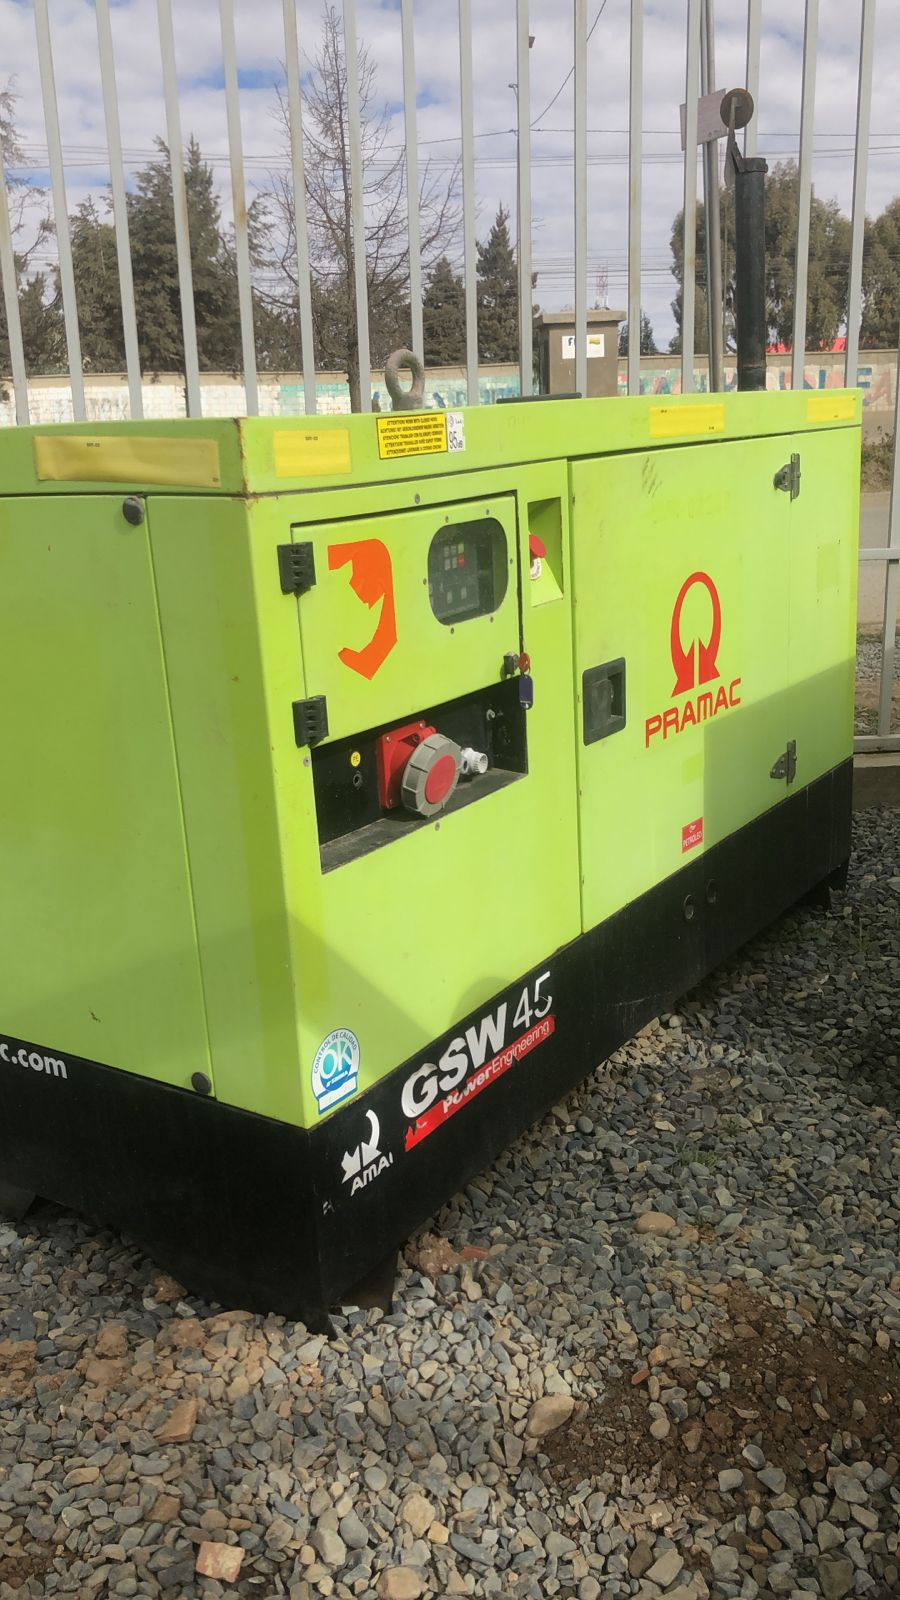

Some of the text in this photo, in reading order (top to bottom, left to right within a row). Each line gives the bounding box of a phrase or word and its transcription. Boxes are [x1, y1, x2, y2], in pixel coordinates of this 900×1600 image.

[645, 678, 741, 749] PRAMAC
[313, 1031, 358, 1074] CONTROL DE CALIDAD
[319, 1039, 352, 1080] OK
[401, 970, 553, 1118] GSW 45
